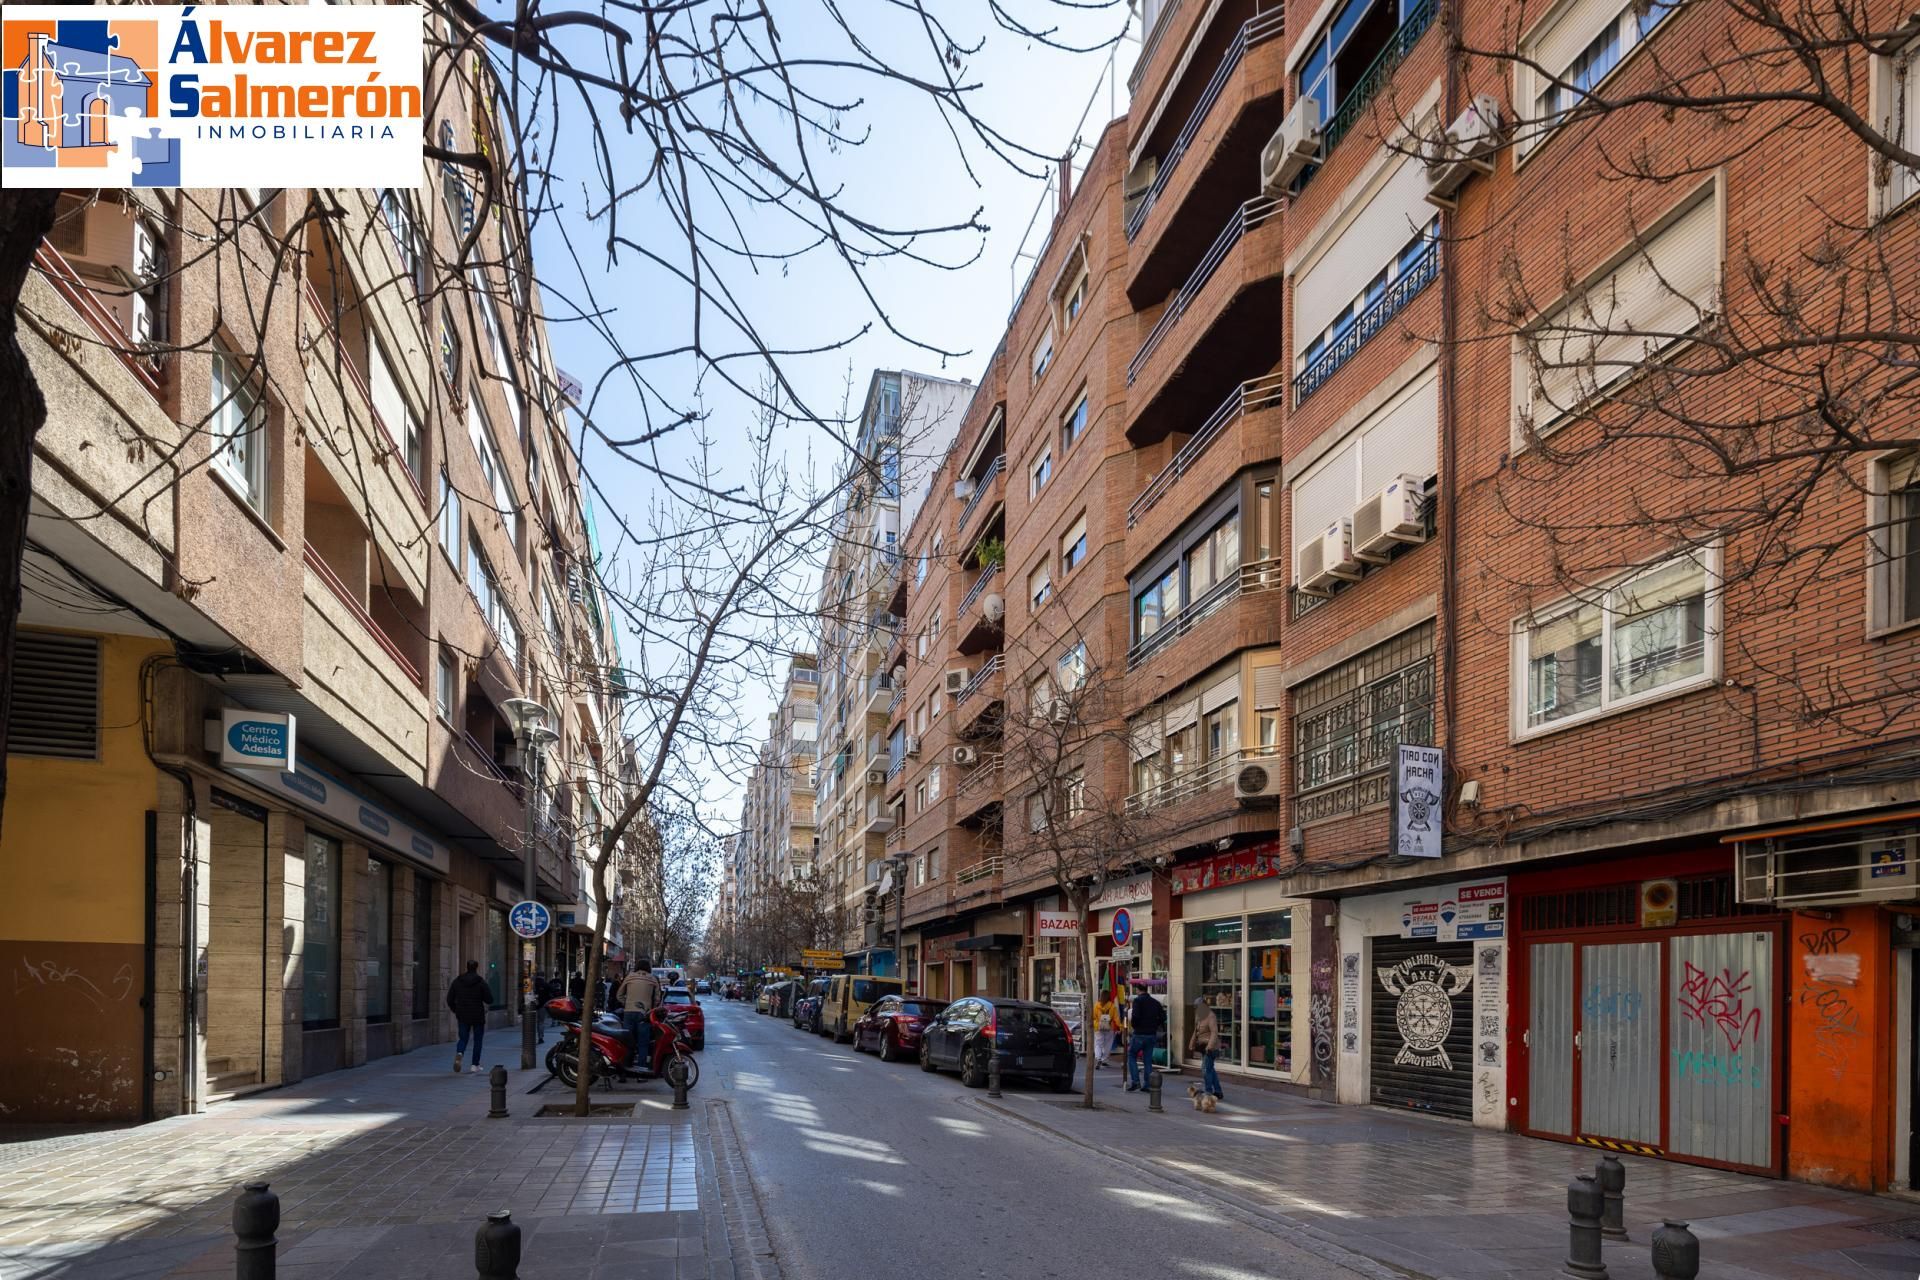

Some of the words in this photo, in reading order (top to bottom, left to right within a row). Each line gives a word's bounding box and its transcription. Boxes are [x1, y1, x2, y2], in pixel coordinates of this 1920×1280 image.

[242, 725, 278, 735] Centro
[242, 734, 281, 745] Médico
[242, 744, 282, 755] Adeslas
[1401, 750, 1420, 765] TIRO
[1422, 752, 1440, 769] CON
[1406, 765, 1434, 784] HACHA
[1460, 890, 1472, 899] SE
[1474, 887, 1503, 897] VENDE
[1040, 919, 1079, 930] BAZAR
[1400, 953, 1446, 976] VALHALLA
[1411, 969, 1436, 982] AXE
[1399, 1050, 1448, 1070] BROTHER
